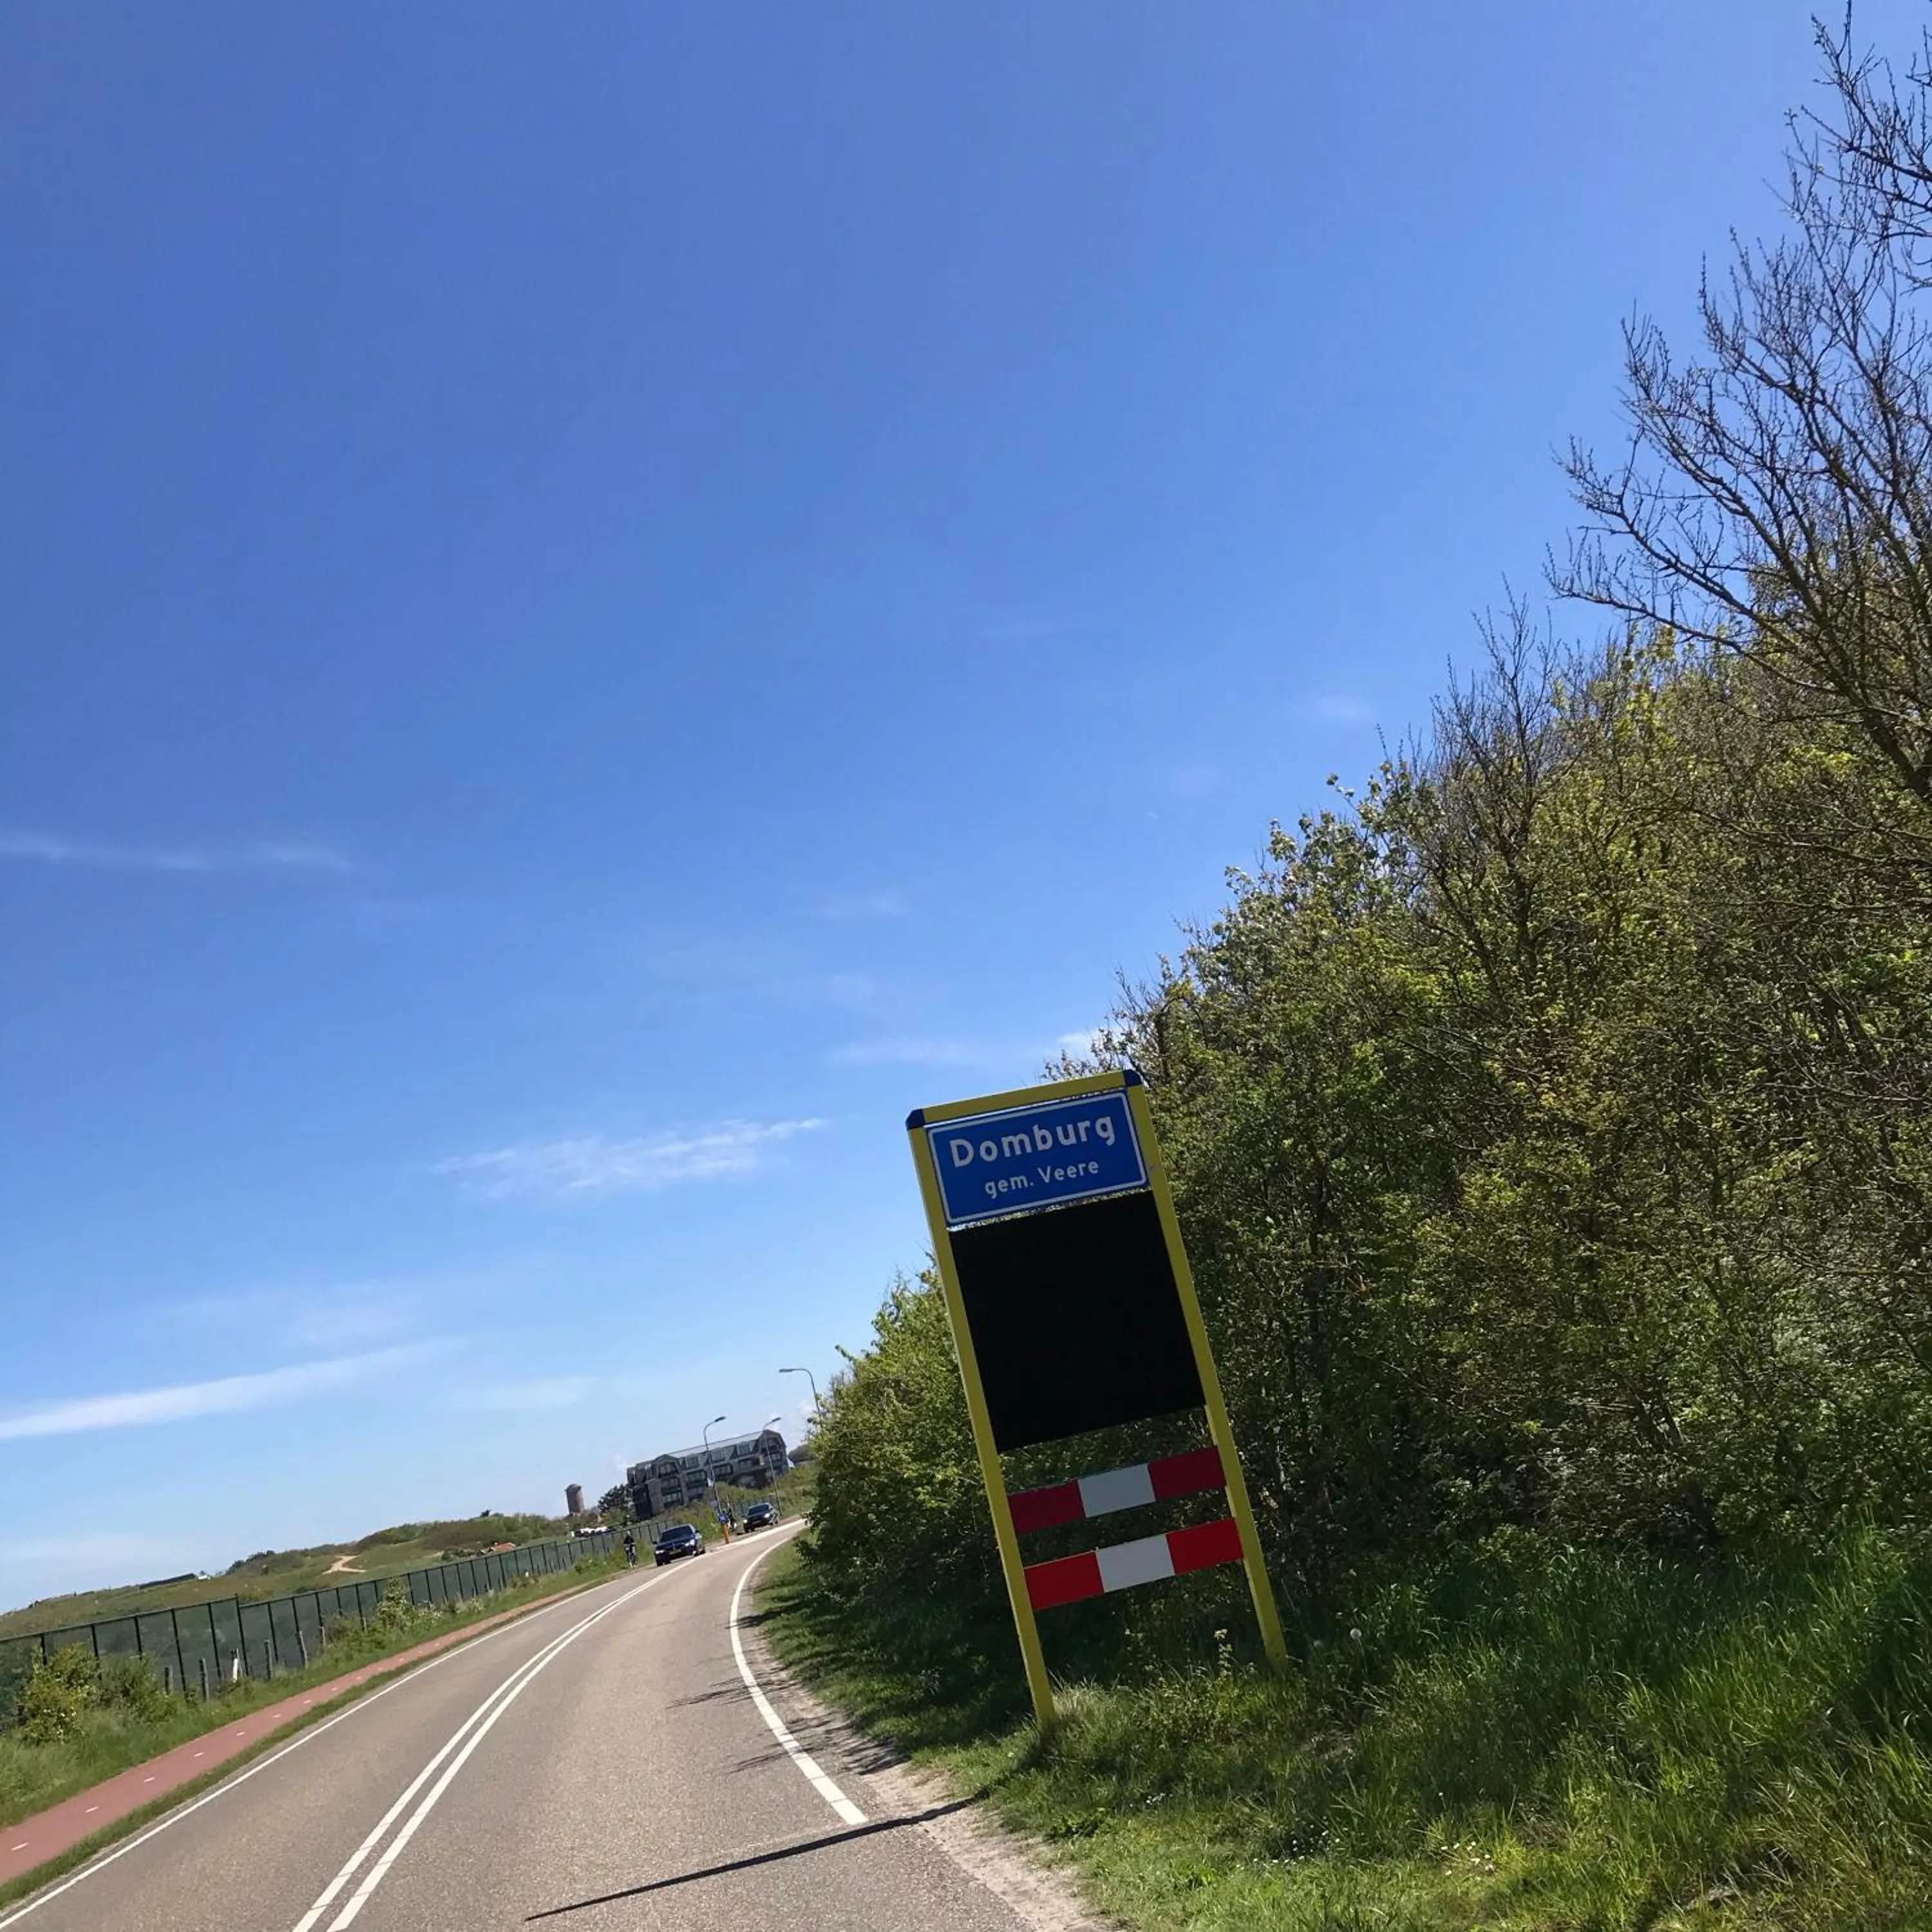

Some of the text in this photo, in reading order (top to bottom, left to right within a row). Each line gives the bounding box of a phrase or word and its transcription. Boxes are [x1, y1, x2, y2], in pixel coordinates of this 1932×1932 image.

[949, 1115, 1115, 1168] Domburg
[985, 1161, 1099, 1199] gem. Veere
